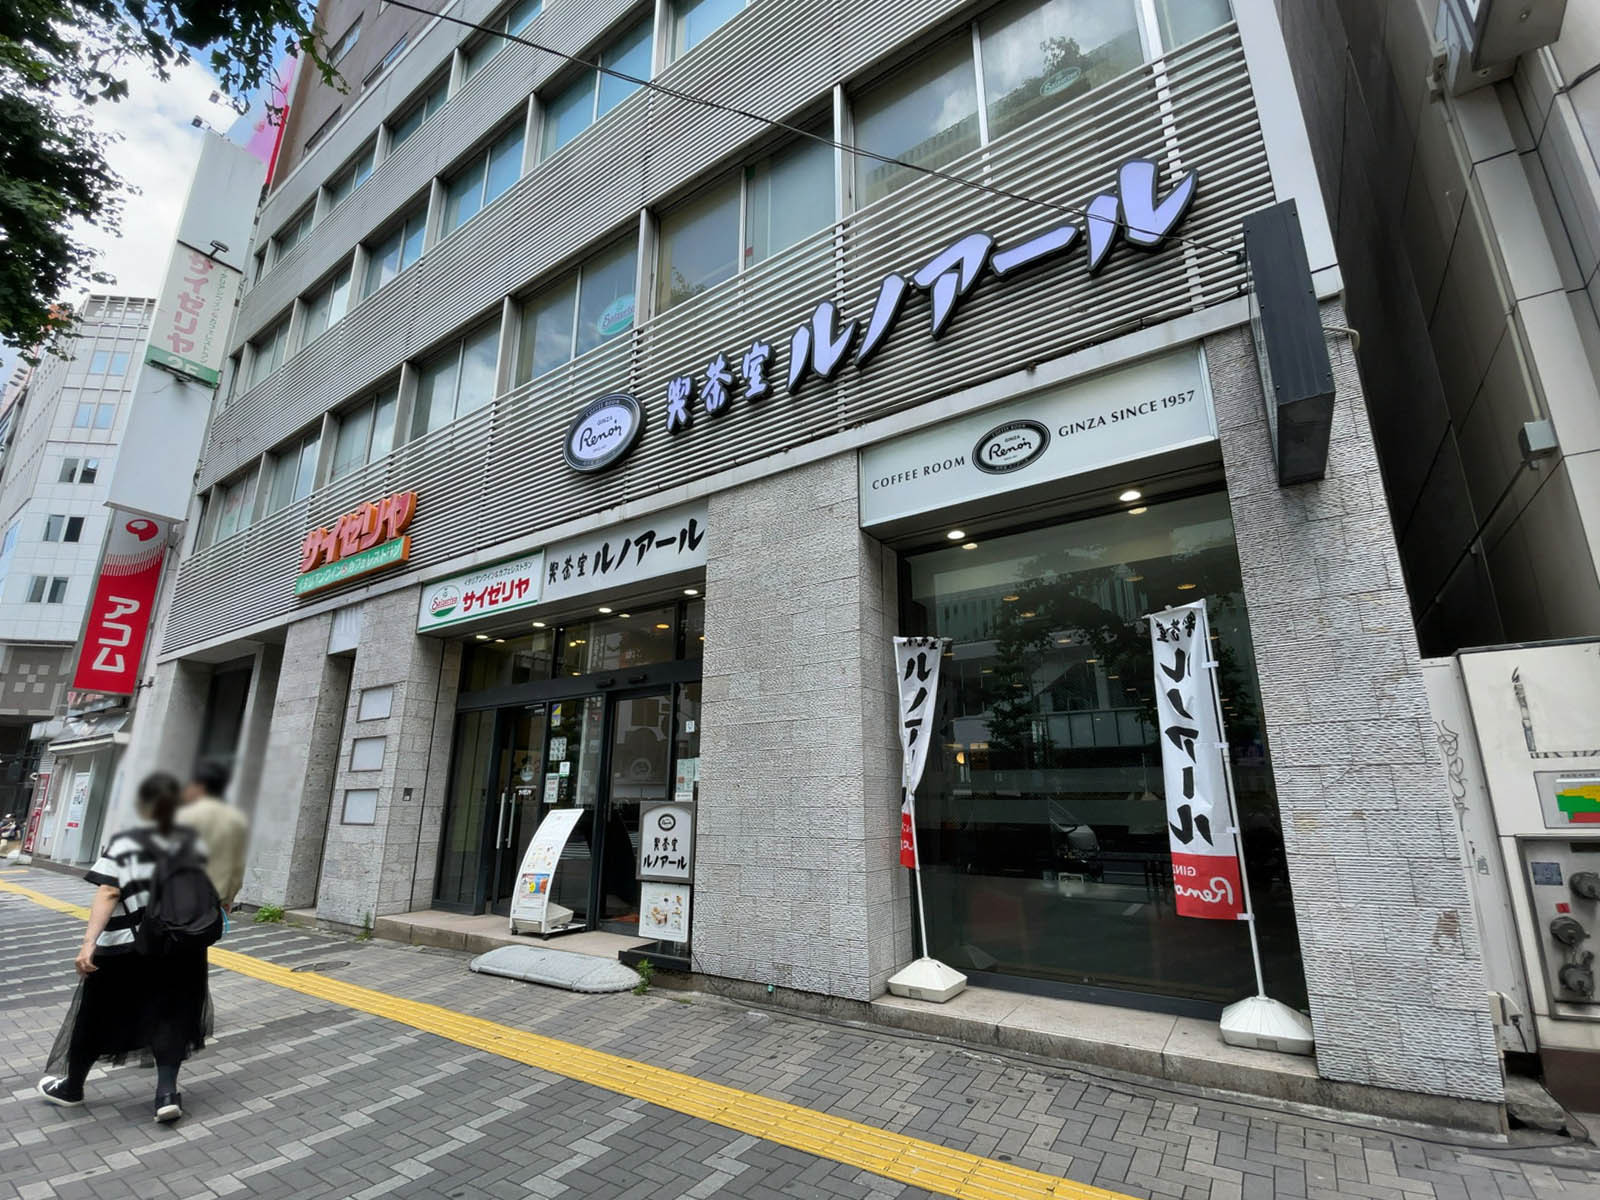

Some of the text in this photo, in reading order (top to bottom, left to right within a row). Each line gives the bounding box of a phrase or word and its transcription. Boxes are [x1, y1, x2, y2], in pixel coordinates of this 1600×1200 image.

[665, 159, 1199, 432] 喫茶室 ルノアール
[1058, 390, 1195, 438] GINZA SINCE 1957
[872, 455, 965, 491] COFFEE ROOM
[301, 491, 417, 573] サイゼリヤ
[548, 518, 705, 585] 喫茶室 ルノアール
[462, 577, 531, 612] サイゼリヤ
[91, 595, 141, 673] アコム
[642, 853, 688, 870] ルノアール
[653, 836, 679, 852] 喫茶室
